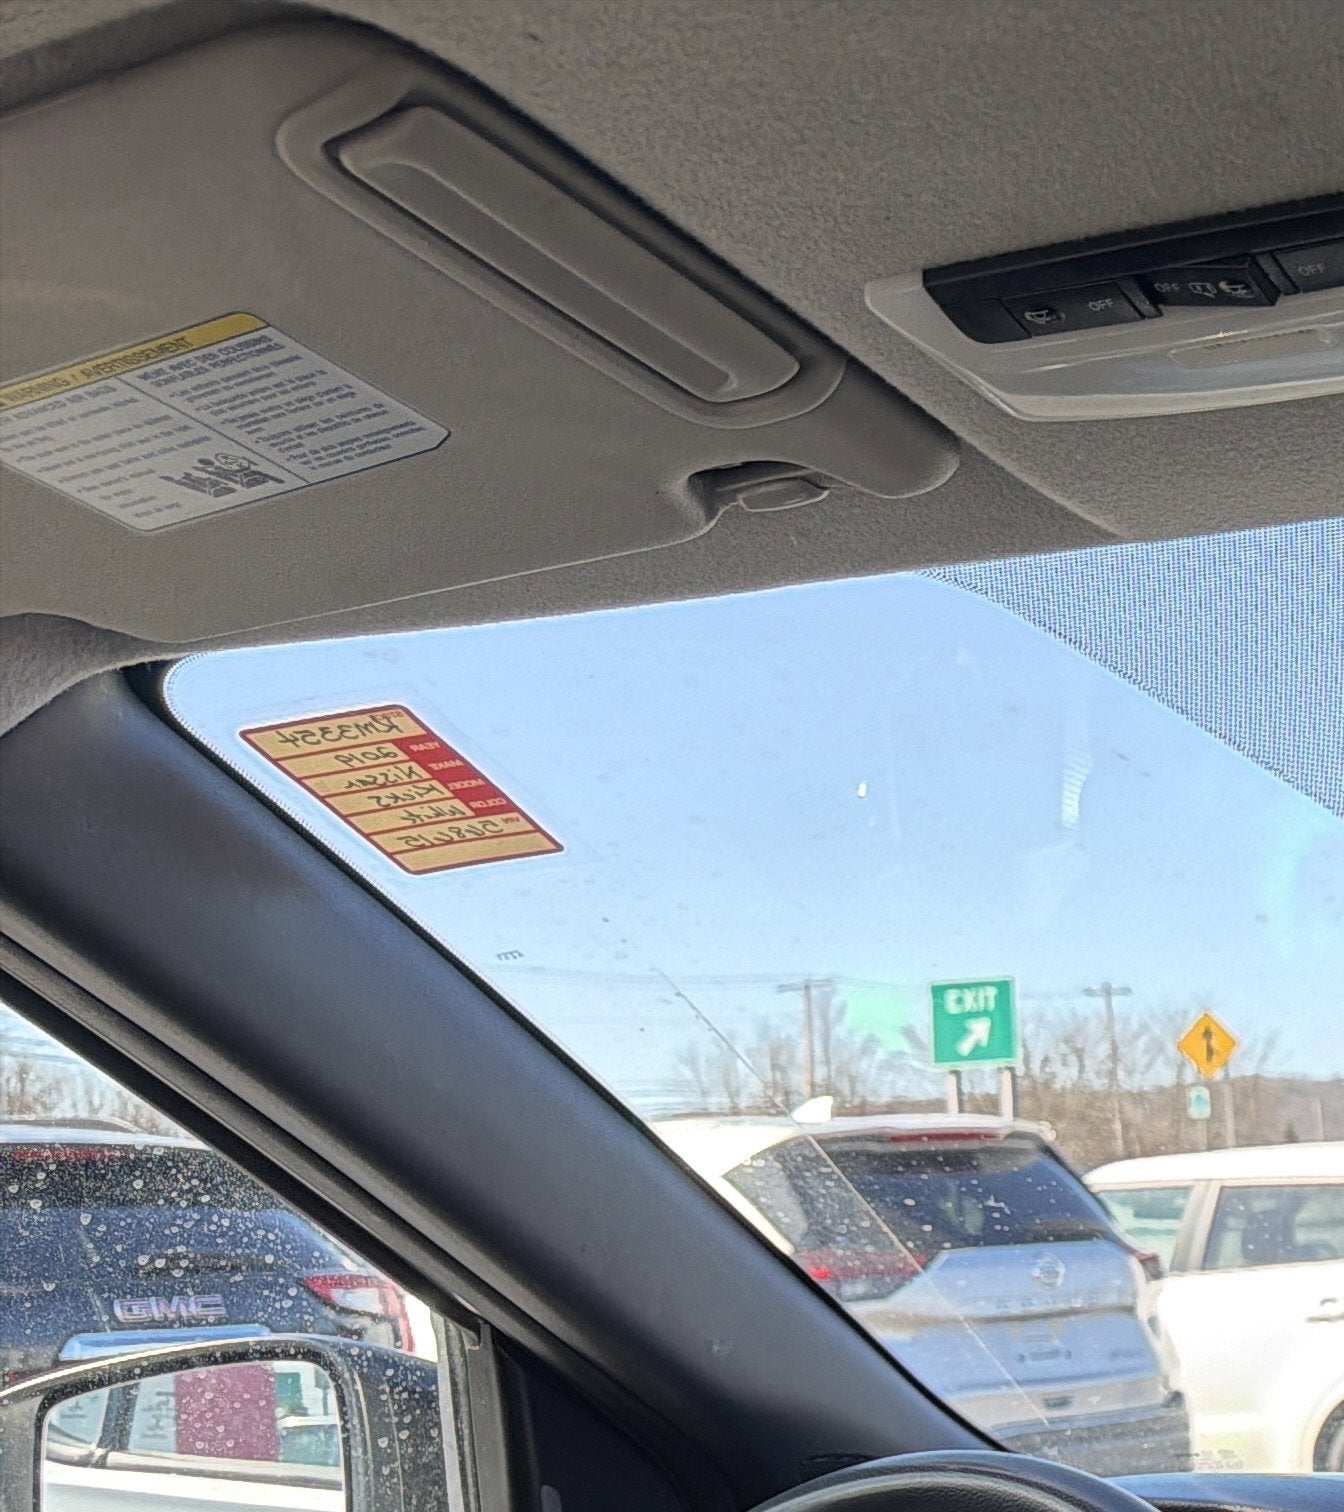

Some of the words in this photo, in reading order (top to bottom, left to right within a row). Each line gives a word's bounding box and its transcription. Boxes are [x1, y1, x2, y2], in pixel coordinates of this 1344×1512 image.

[1297, 263, 1326, 277] OFF
[1152, 282, 1181, 294] OFF
[1088, 298, 1116, 312] OFF
[943, 986, 999, 1014] EXIT
[113, 1294, 227, 1322] GMC
